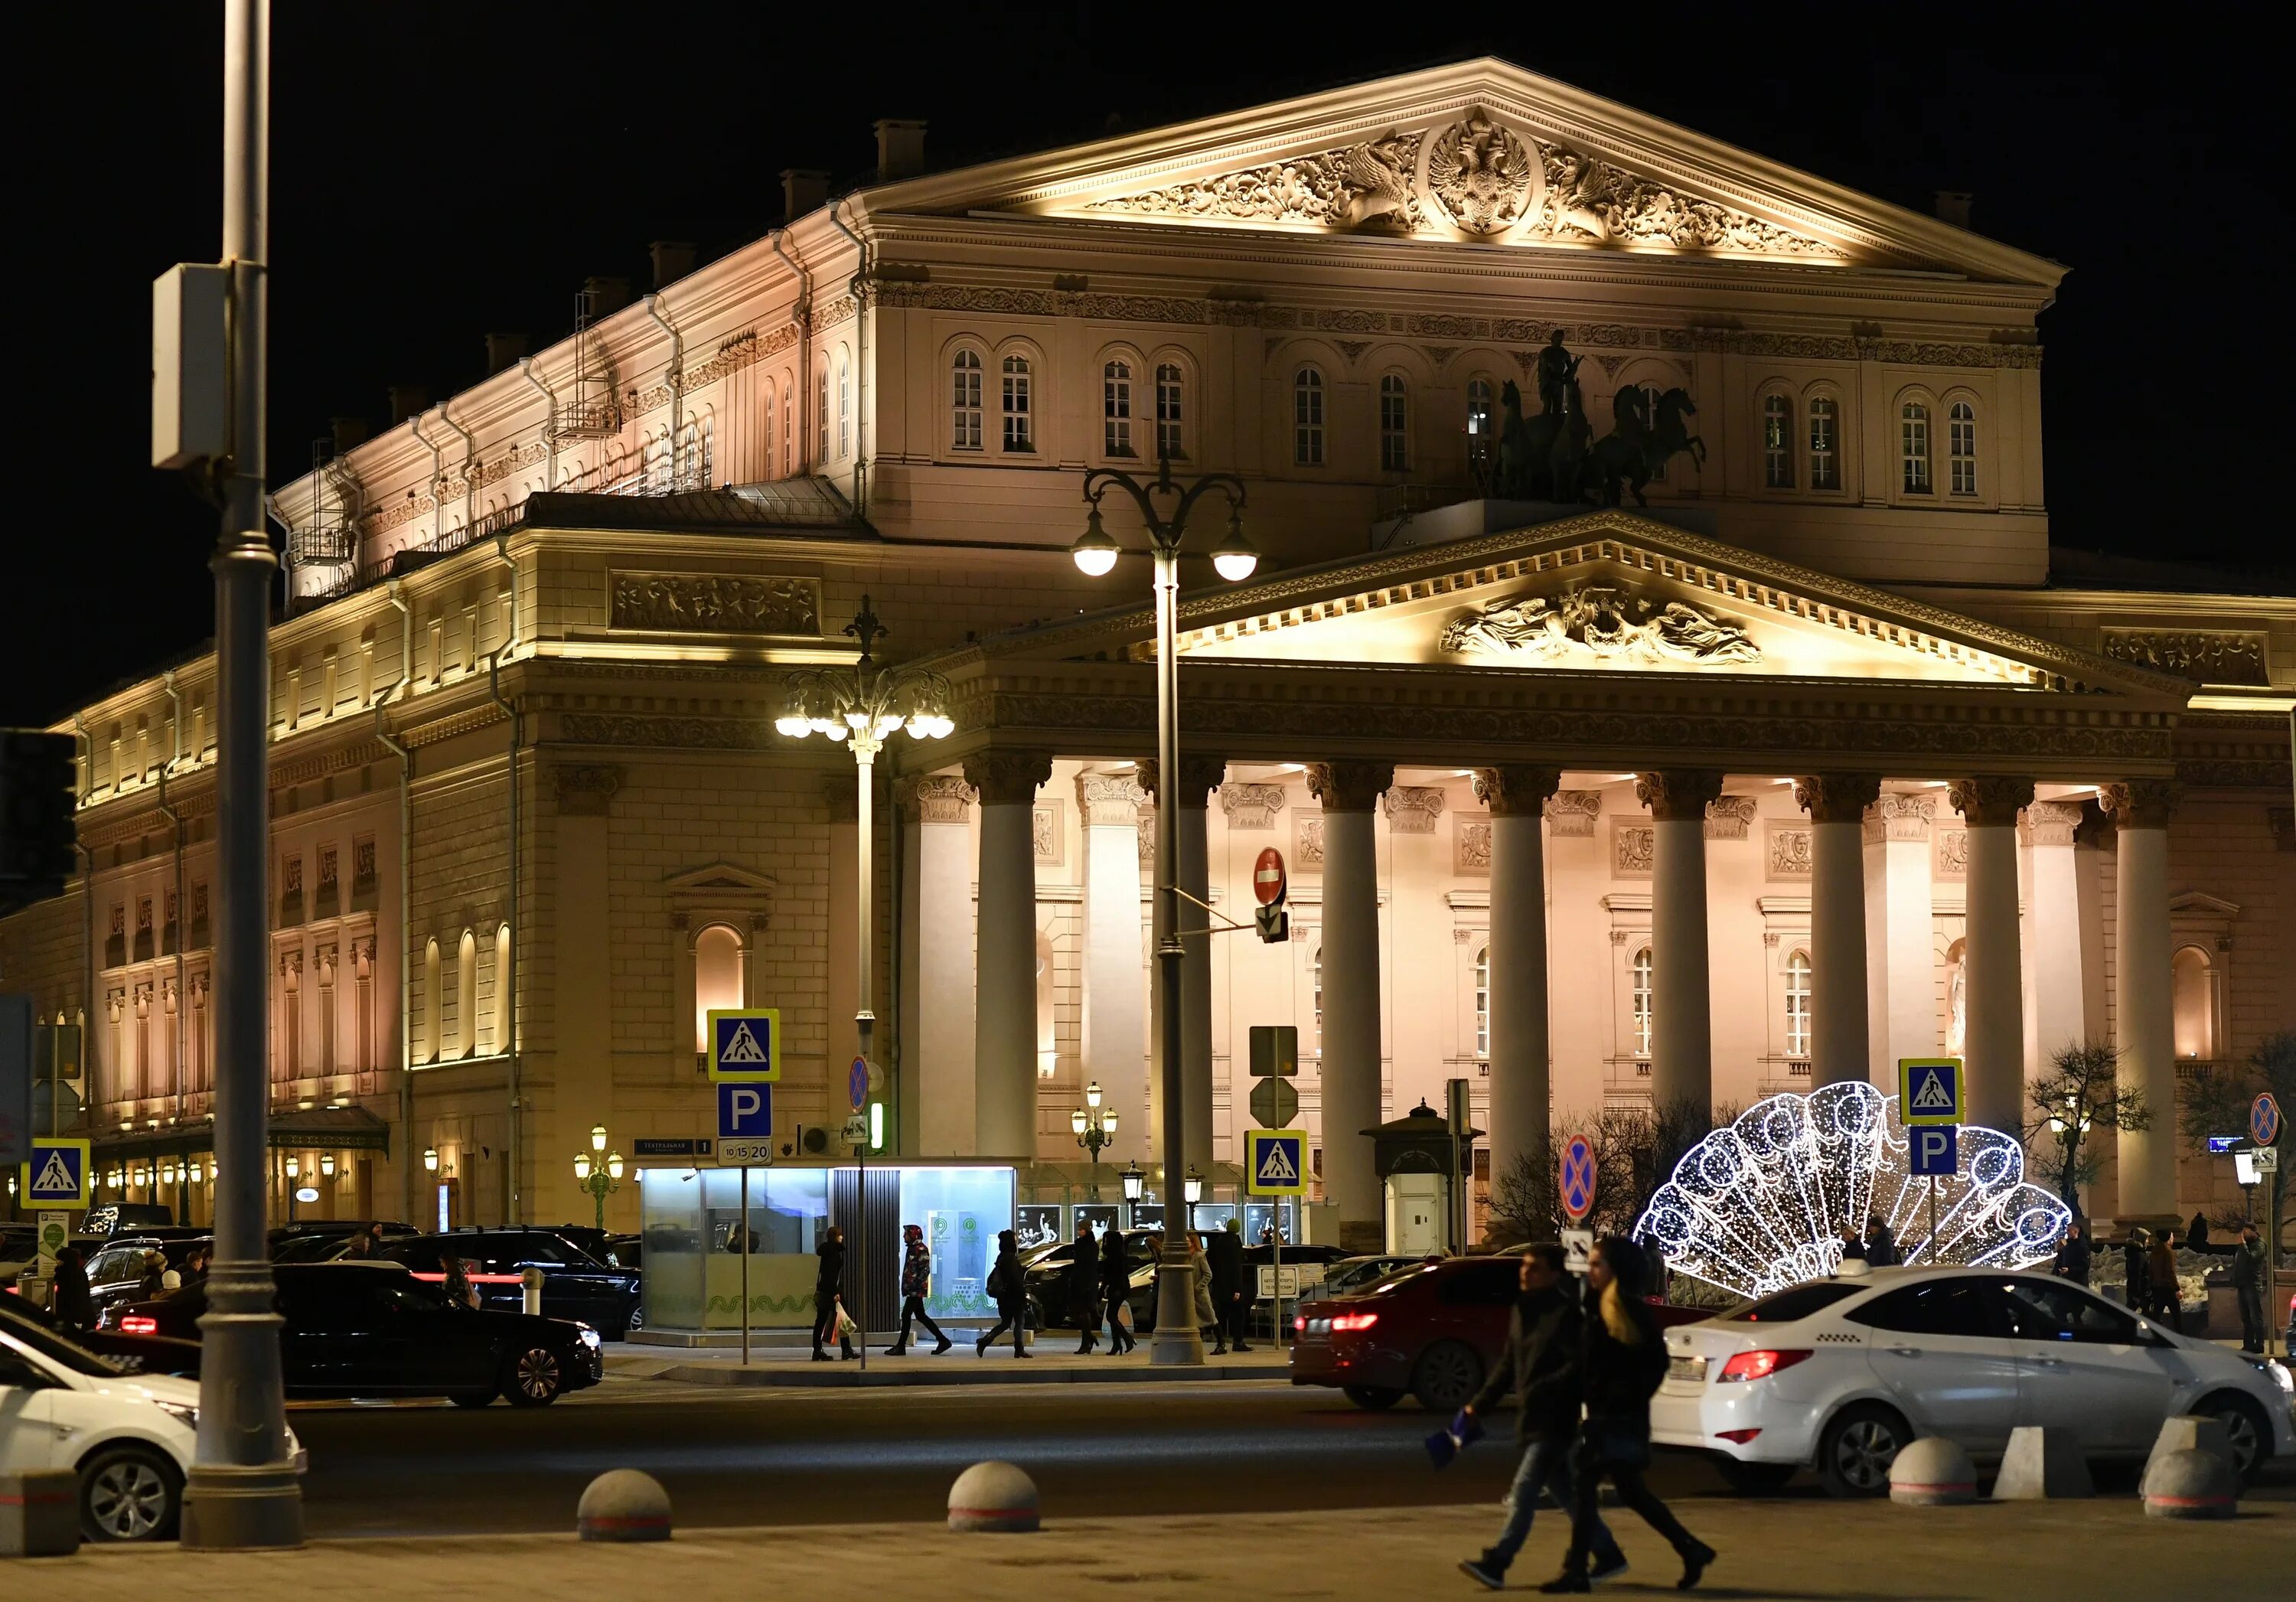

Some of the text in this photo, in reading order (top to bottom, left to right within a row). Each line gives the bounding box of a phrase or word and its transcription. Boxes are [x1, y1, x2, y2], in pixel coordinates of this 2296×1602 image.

[732, 1090, 760, 1130] P
[702, 1142, 706, 1152] 1
[738, 1148, 748, 1157] 15
[752, 1147, 767, 1158] 20
[1922, 1132, 1947, 1169] P
